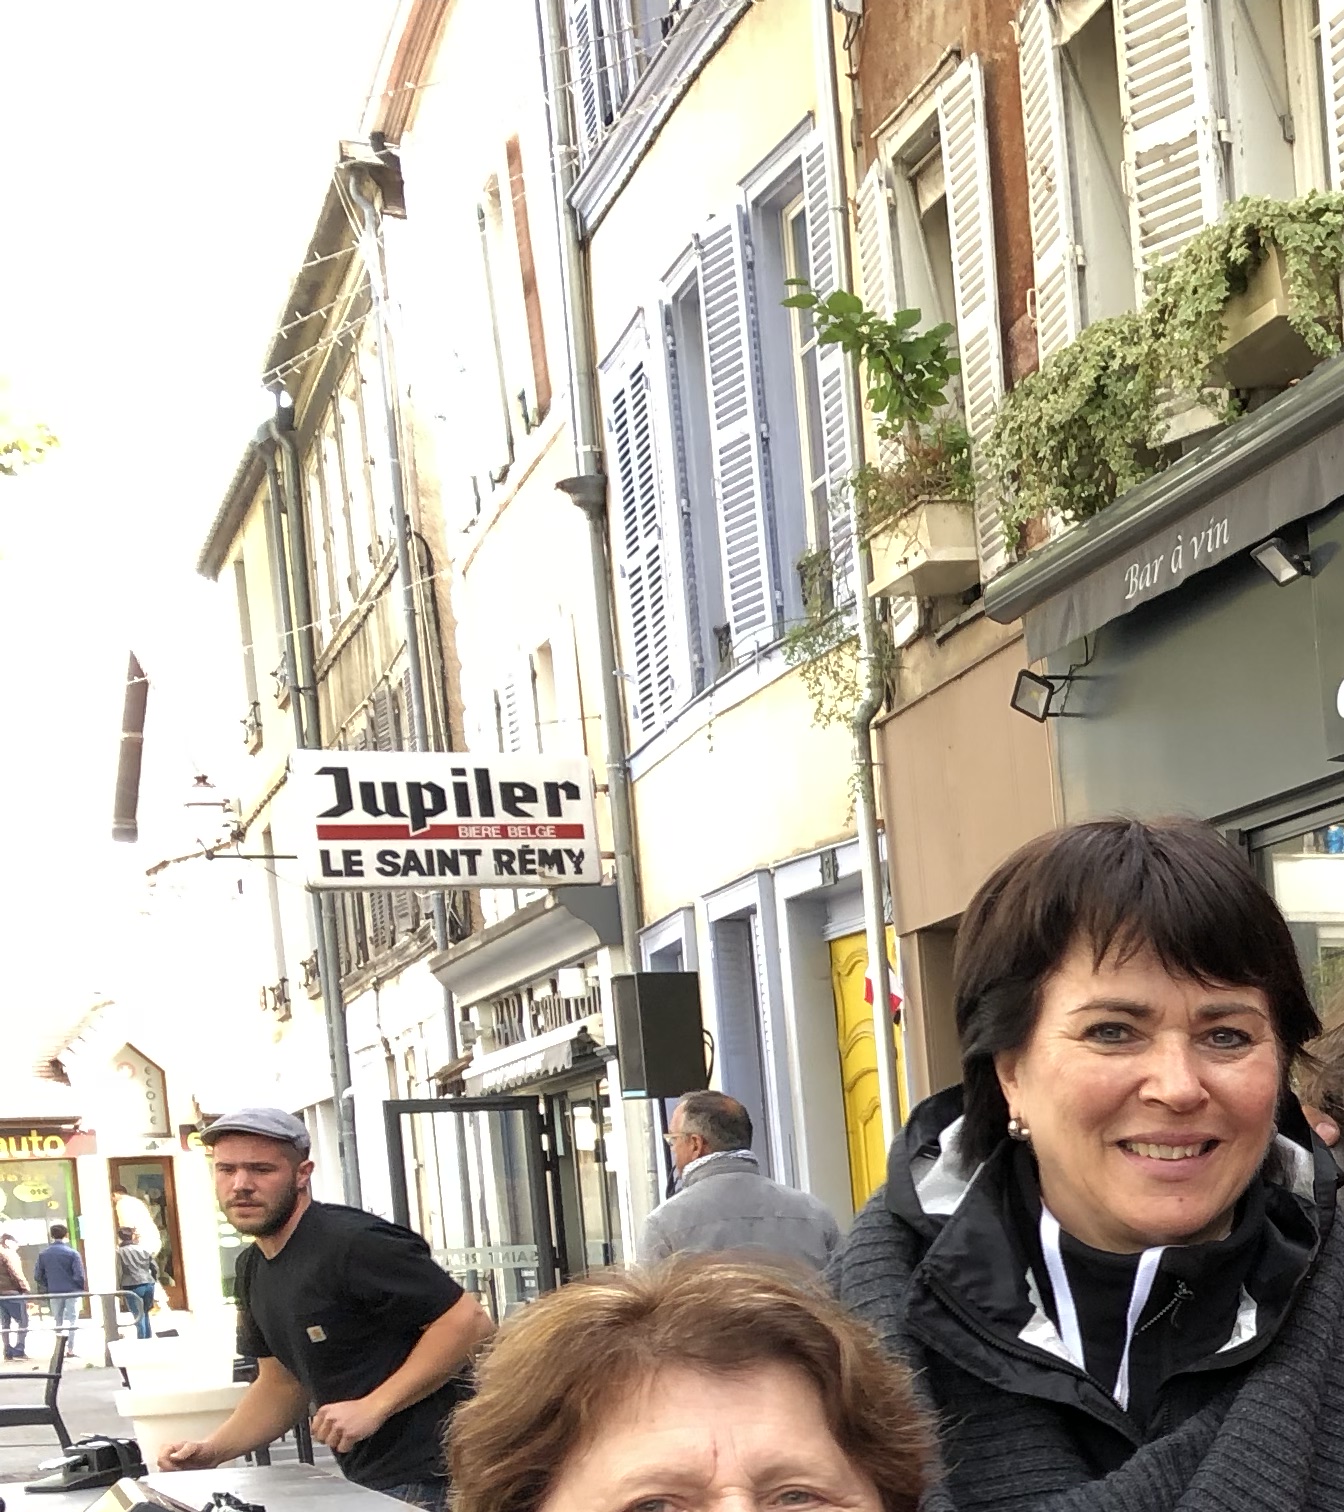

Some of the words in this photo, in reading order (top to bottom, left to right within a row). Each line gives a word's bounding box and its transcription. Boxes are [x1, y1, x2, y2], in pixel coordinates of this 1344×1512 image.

[1124, 554, 1165, 600] Bar
[1170, 534, 1183, 574] à
[1190, 516, 1230, 560] vin
[314, 766, 581, 832] Jupiler
[458, 825, 501, 838] BIERE
[507, 825, 556, 838] BELGE
[319, 849, 364, 877] LE
[375, 849, 481, 877] SAINT
[491, 844, 585, 877] RÉMY
